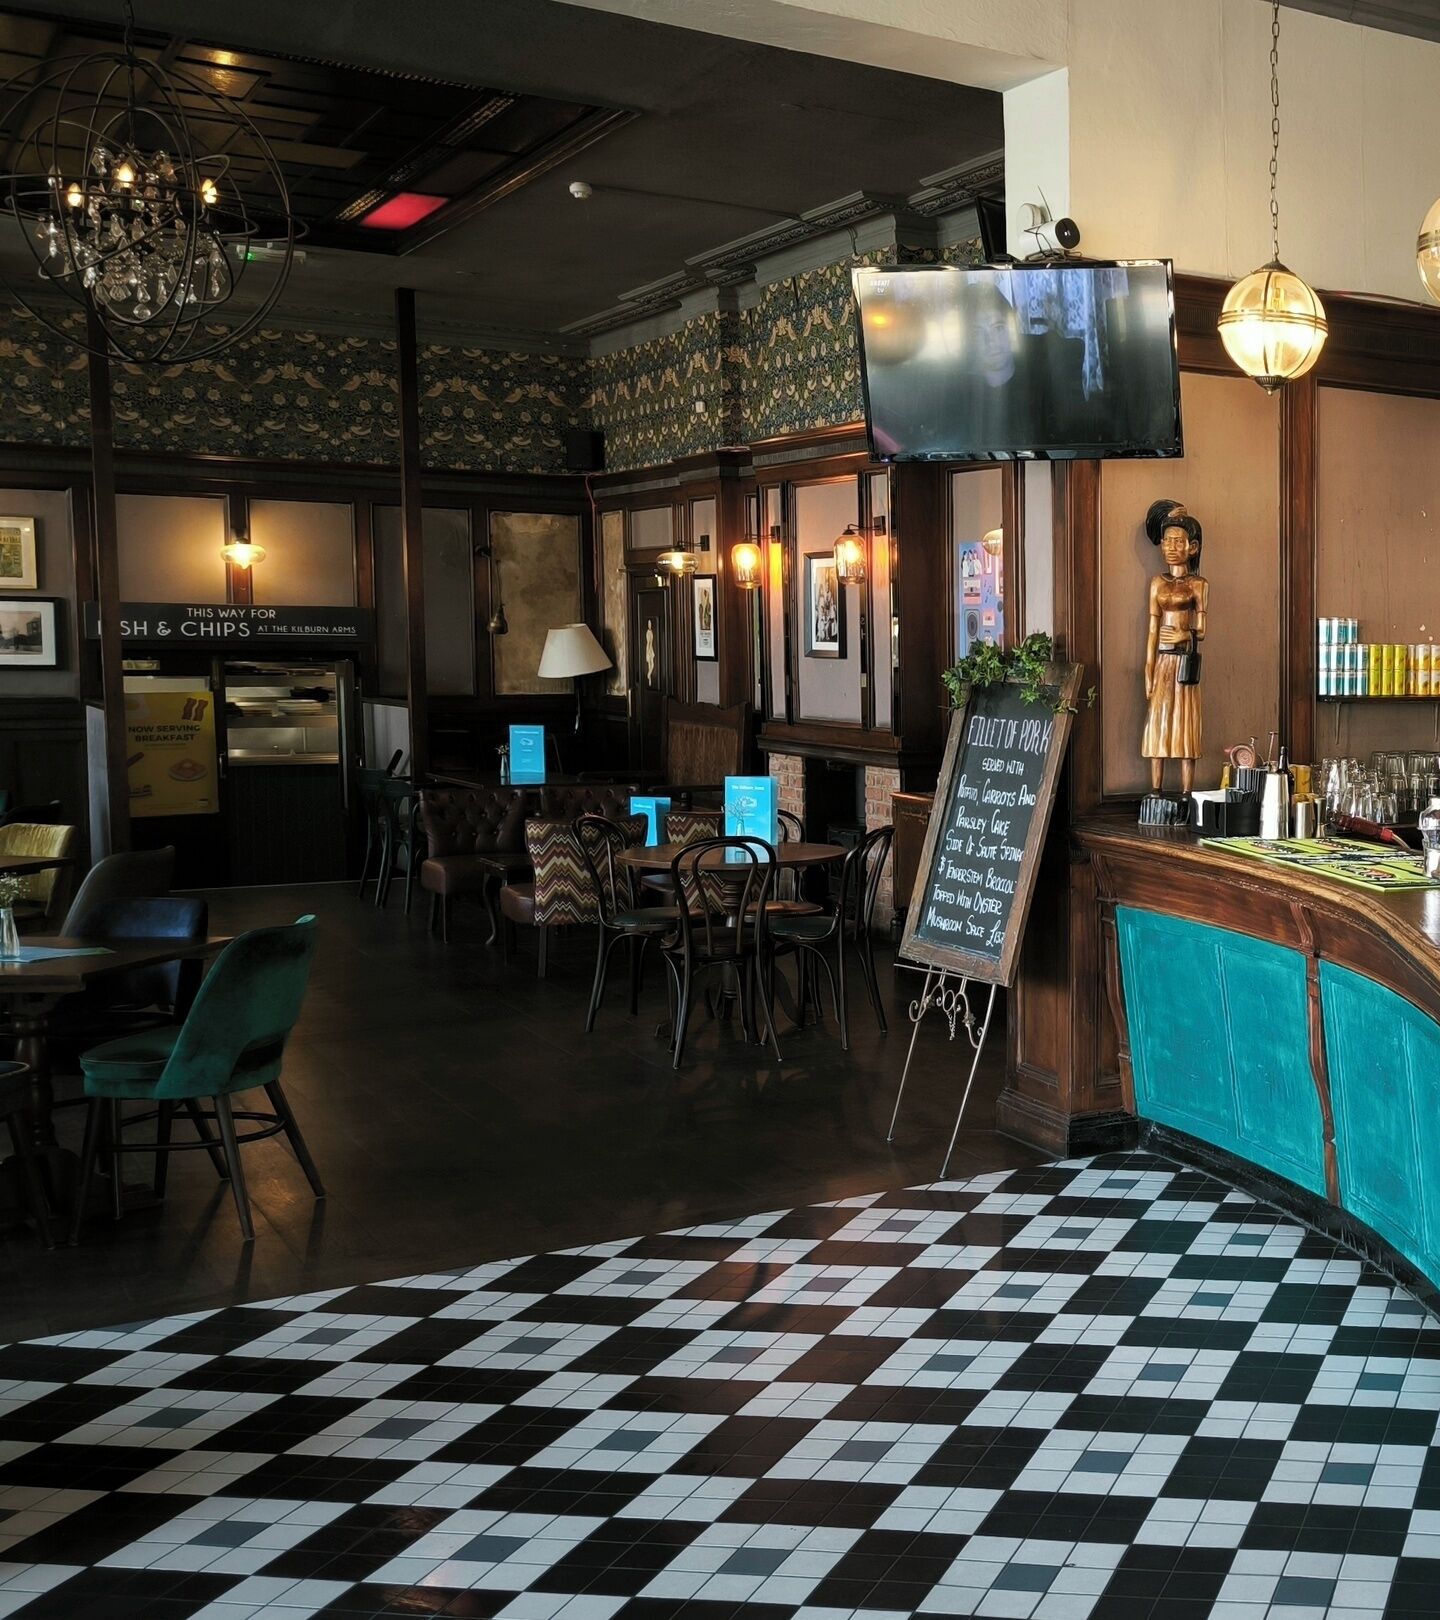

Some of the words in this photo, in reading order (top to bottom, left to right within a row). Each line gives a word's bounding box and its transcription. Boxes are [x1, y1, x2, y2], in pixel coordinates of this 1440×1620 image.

[187, 608, 214, 618] THIS
[217, 608, 245, 619] WAY
[251, 609, 276, 619] FOR
[157, 622, 172, 636] &
[181, 622, 250, 637] CHIPS
[292, 626, 329, 634] KILBURN
[135, 734, 195, 742] BREAKFAST
[156, 724, 200, 733] SERVING
[1004, 719, 1019, 749] OF
[1018, 719, 1053, 756] PORK
[1006, 760, 1025, 776] WITH
[1018, 784, 1036, 806] AND
[956, 806, 987, 834] PARSLEY
[946, 831, 964, 852] SIDE
[966, 835, 975, 856] OF
[933, 884, 955, 904] TOPPED
[973, 891, 1002, 915] OYSTER
